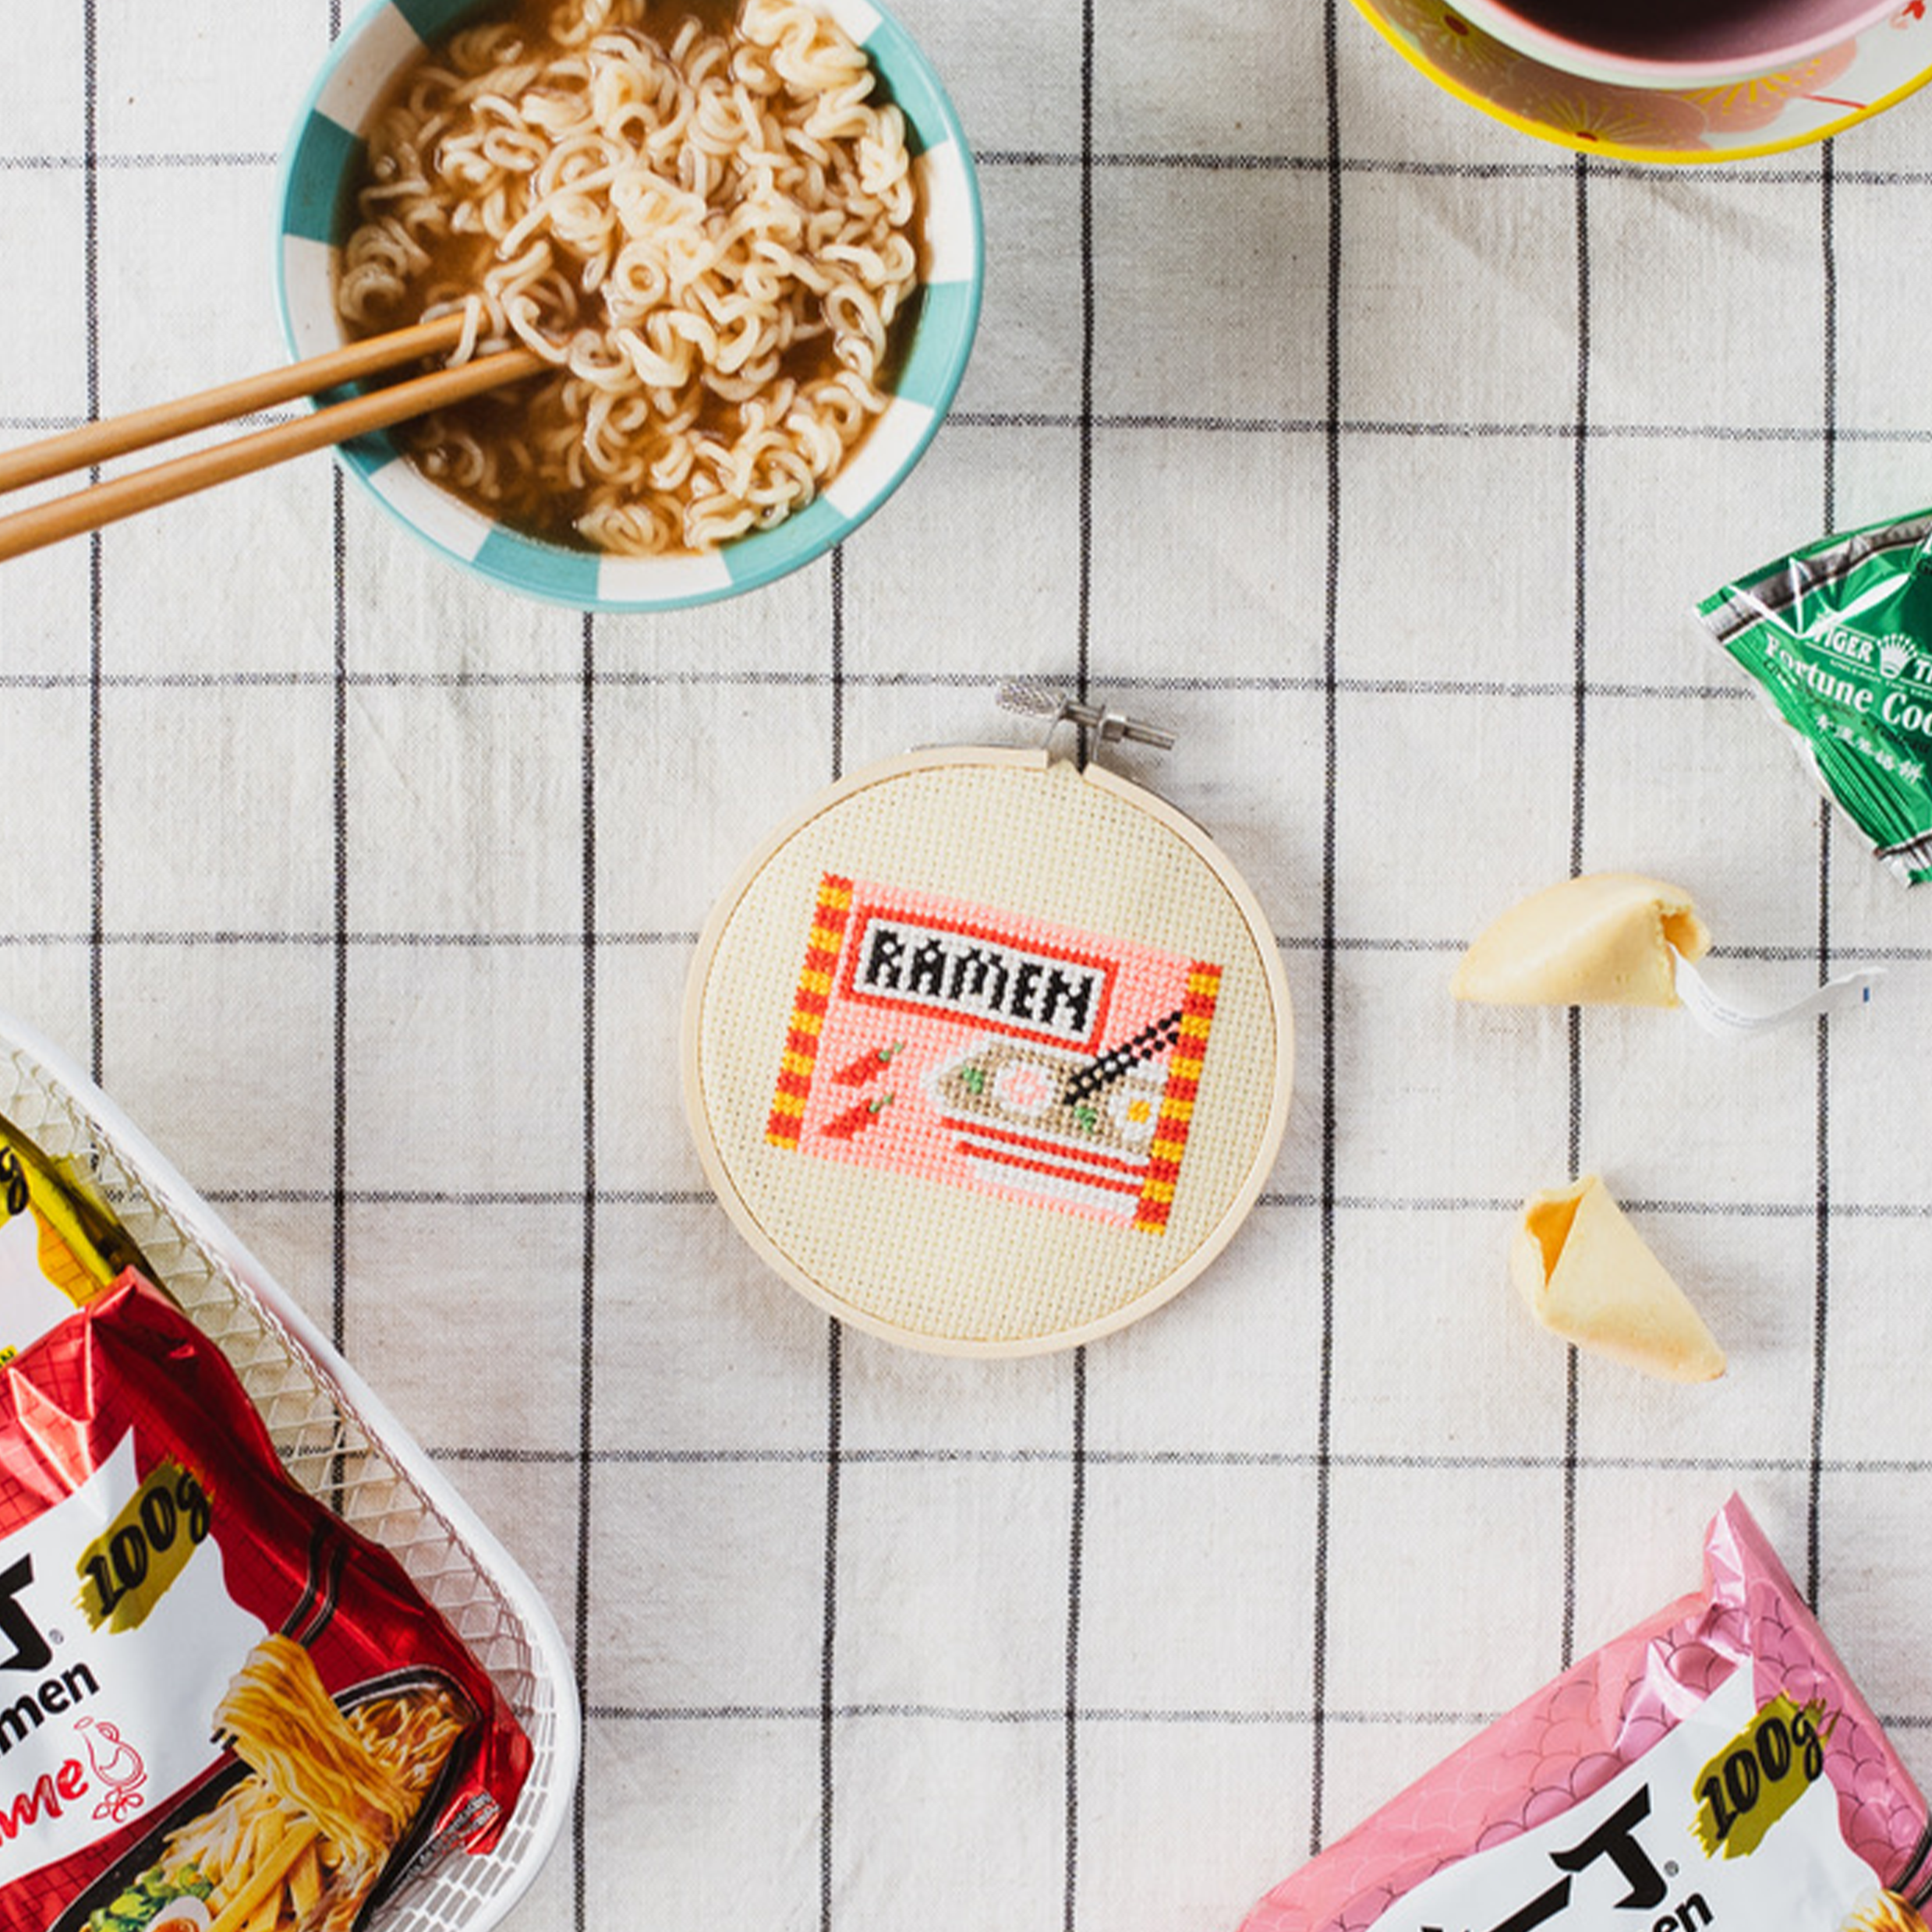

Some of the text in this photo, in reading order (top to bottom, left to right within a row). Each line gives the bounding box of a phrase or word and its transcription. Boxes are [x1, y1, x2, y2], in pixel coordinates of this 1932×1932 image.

[1764, 632, 1874, 713] Fortune
[866, 929, 1092, 1032] RAMEN
[85, 1472, 211, 1617] 100g
[1700, 1711, 1824, 1841] 100g
